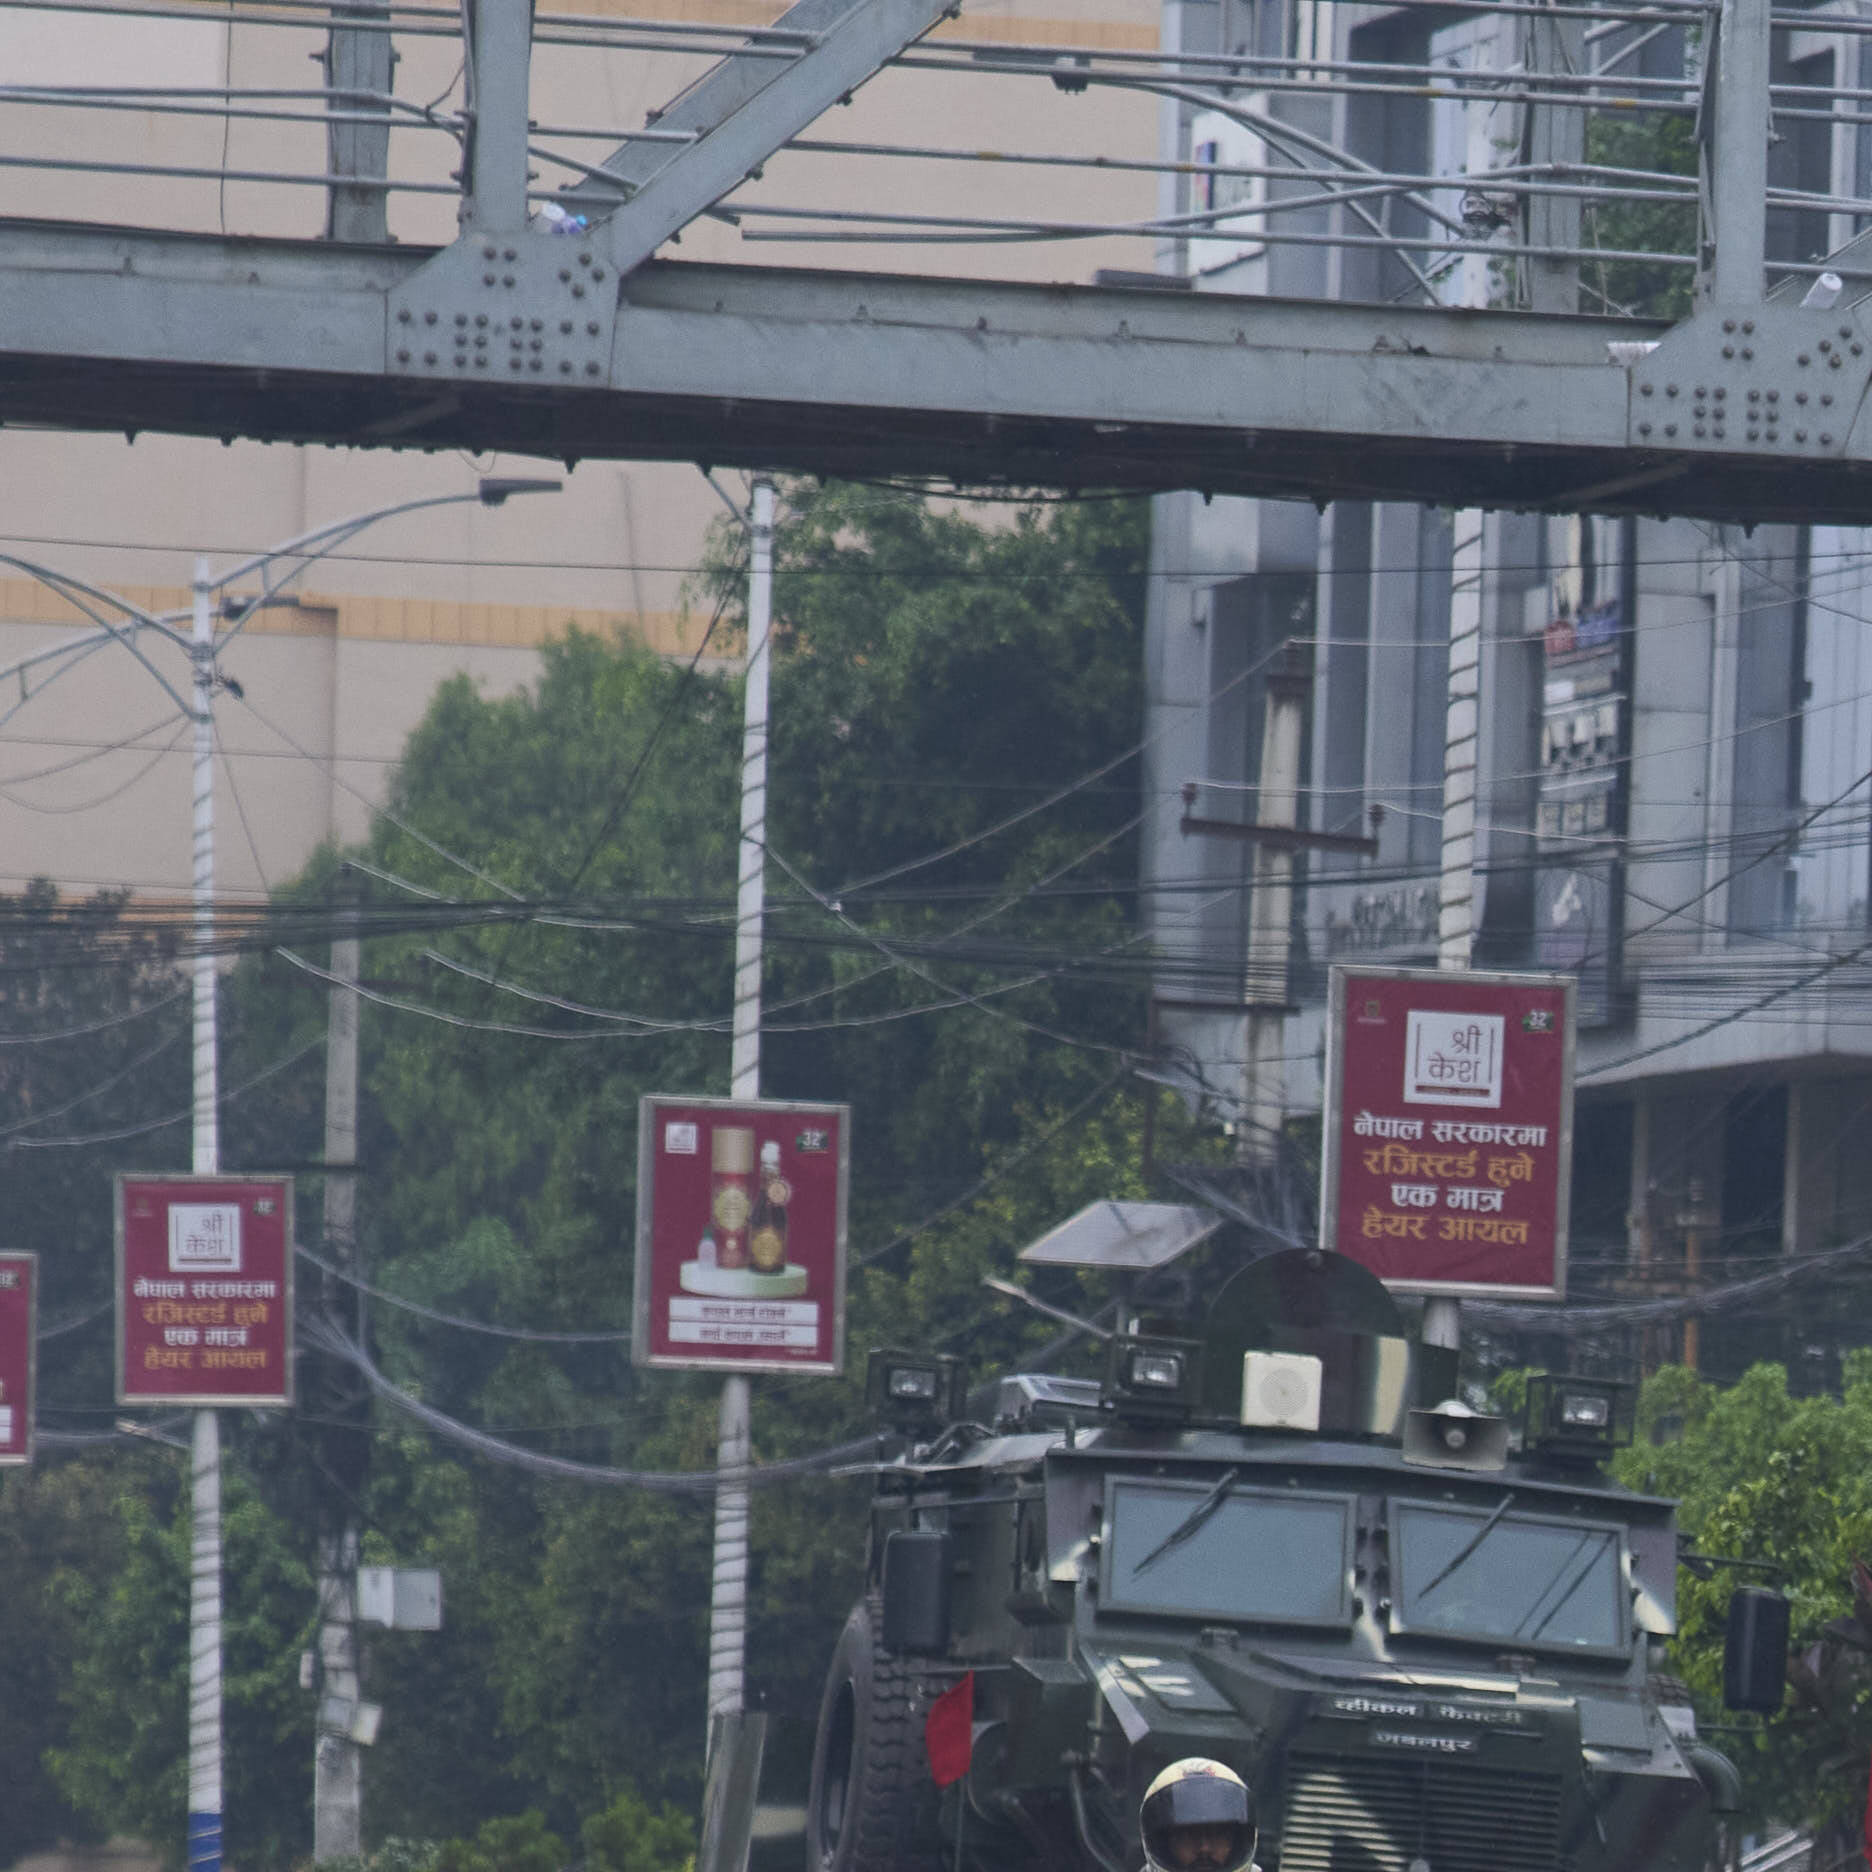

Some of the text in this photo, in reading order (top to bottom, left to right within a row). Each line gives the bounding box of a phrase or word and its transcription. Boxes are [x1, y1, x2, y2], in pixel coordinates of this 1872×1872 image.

[1452, 1024, 1481, 1055] श्री
[1428, 1052, 1482, 1083] केश
[1353, 1109, 1548, 1147] नेपाल सरकारमा
[1363, 1144, 1536, 1188] रजिस्टर्ड हुने
[1391, 1182, 1504, 1213] एक मात्र
[1362, 1207, 1529, 1245] हेयर आयल
[133, 1276, 277, 1300] नेपाल सरकारमा
[164, 1328, 200, 1347] एक
